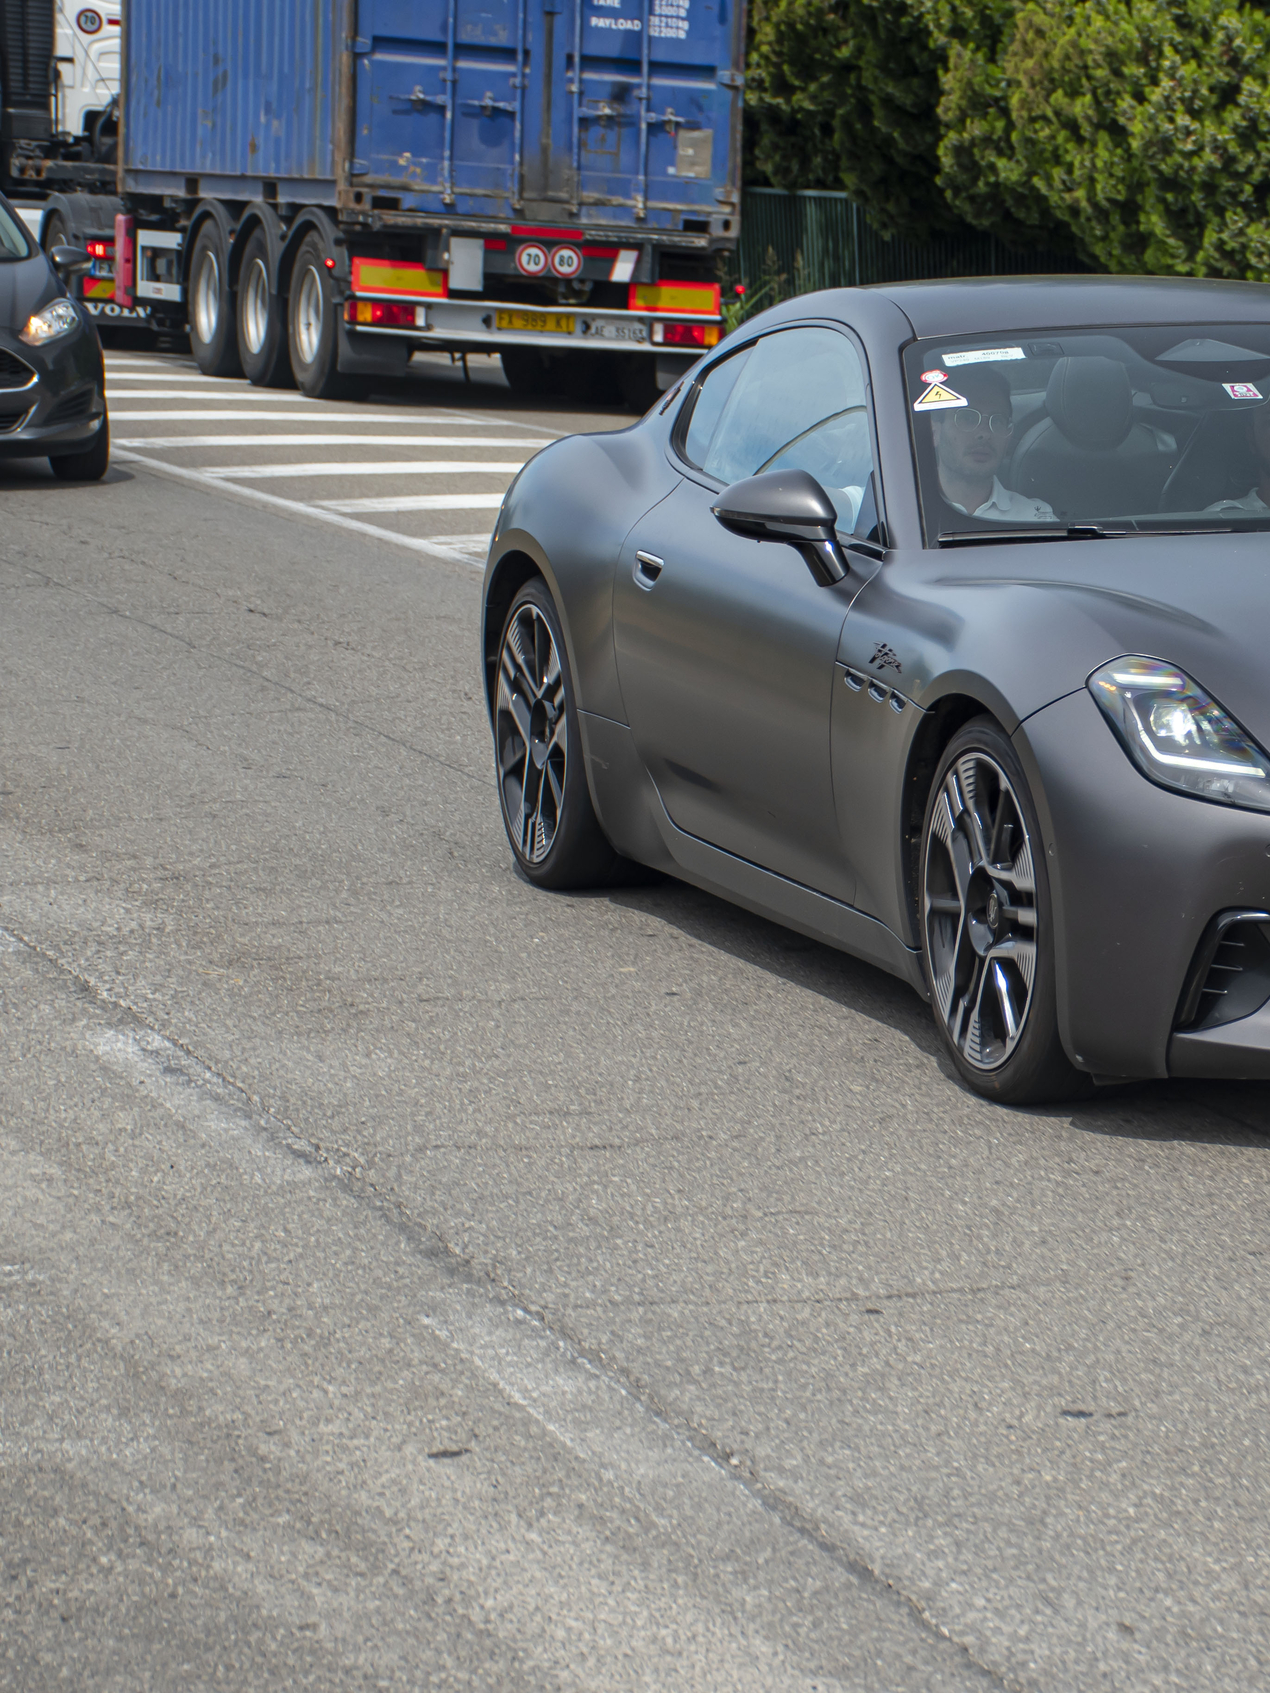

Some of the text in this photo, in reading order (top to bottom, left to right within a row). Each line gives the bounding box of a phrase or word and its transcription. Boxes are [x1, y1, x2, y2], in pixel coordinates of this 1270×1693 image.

[590, 17, 642, 31] PAYLOAD
[526, 253, 541, 266] 70
[558, 255, 573, 268] 80
